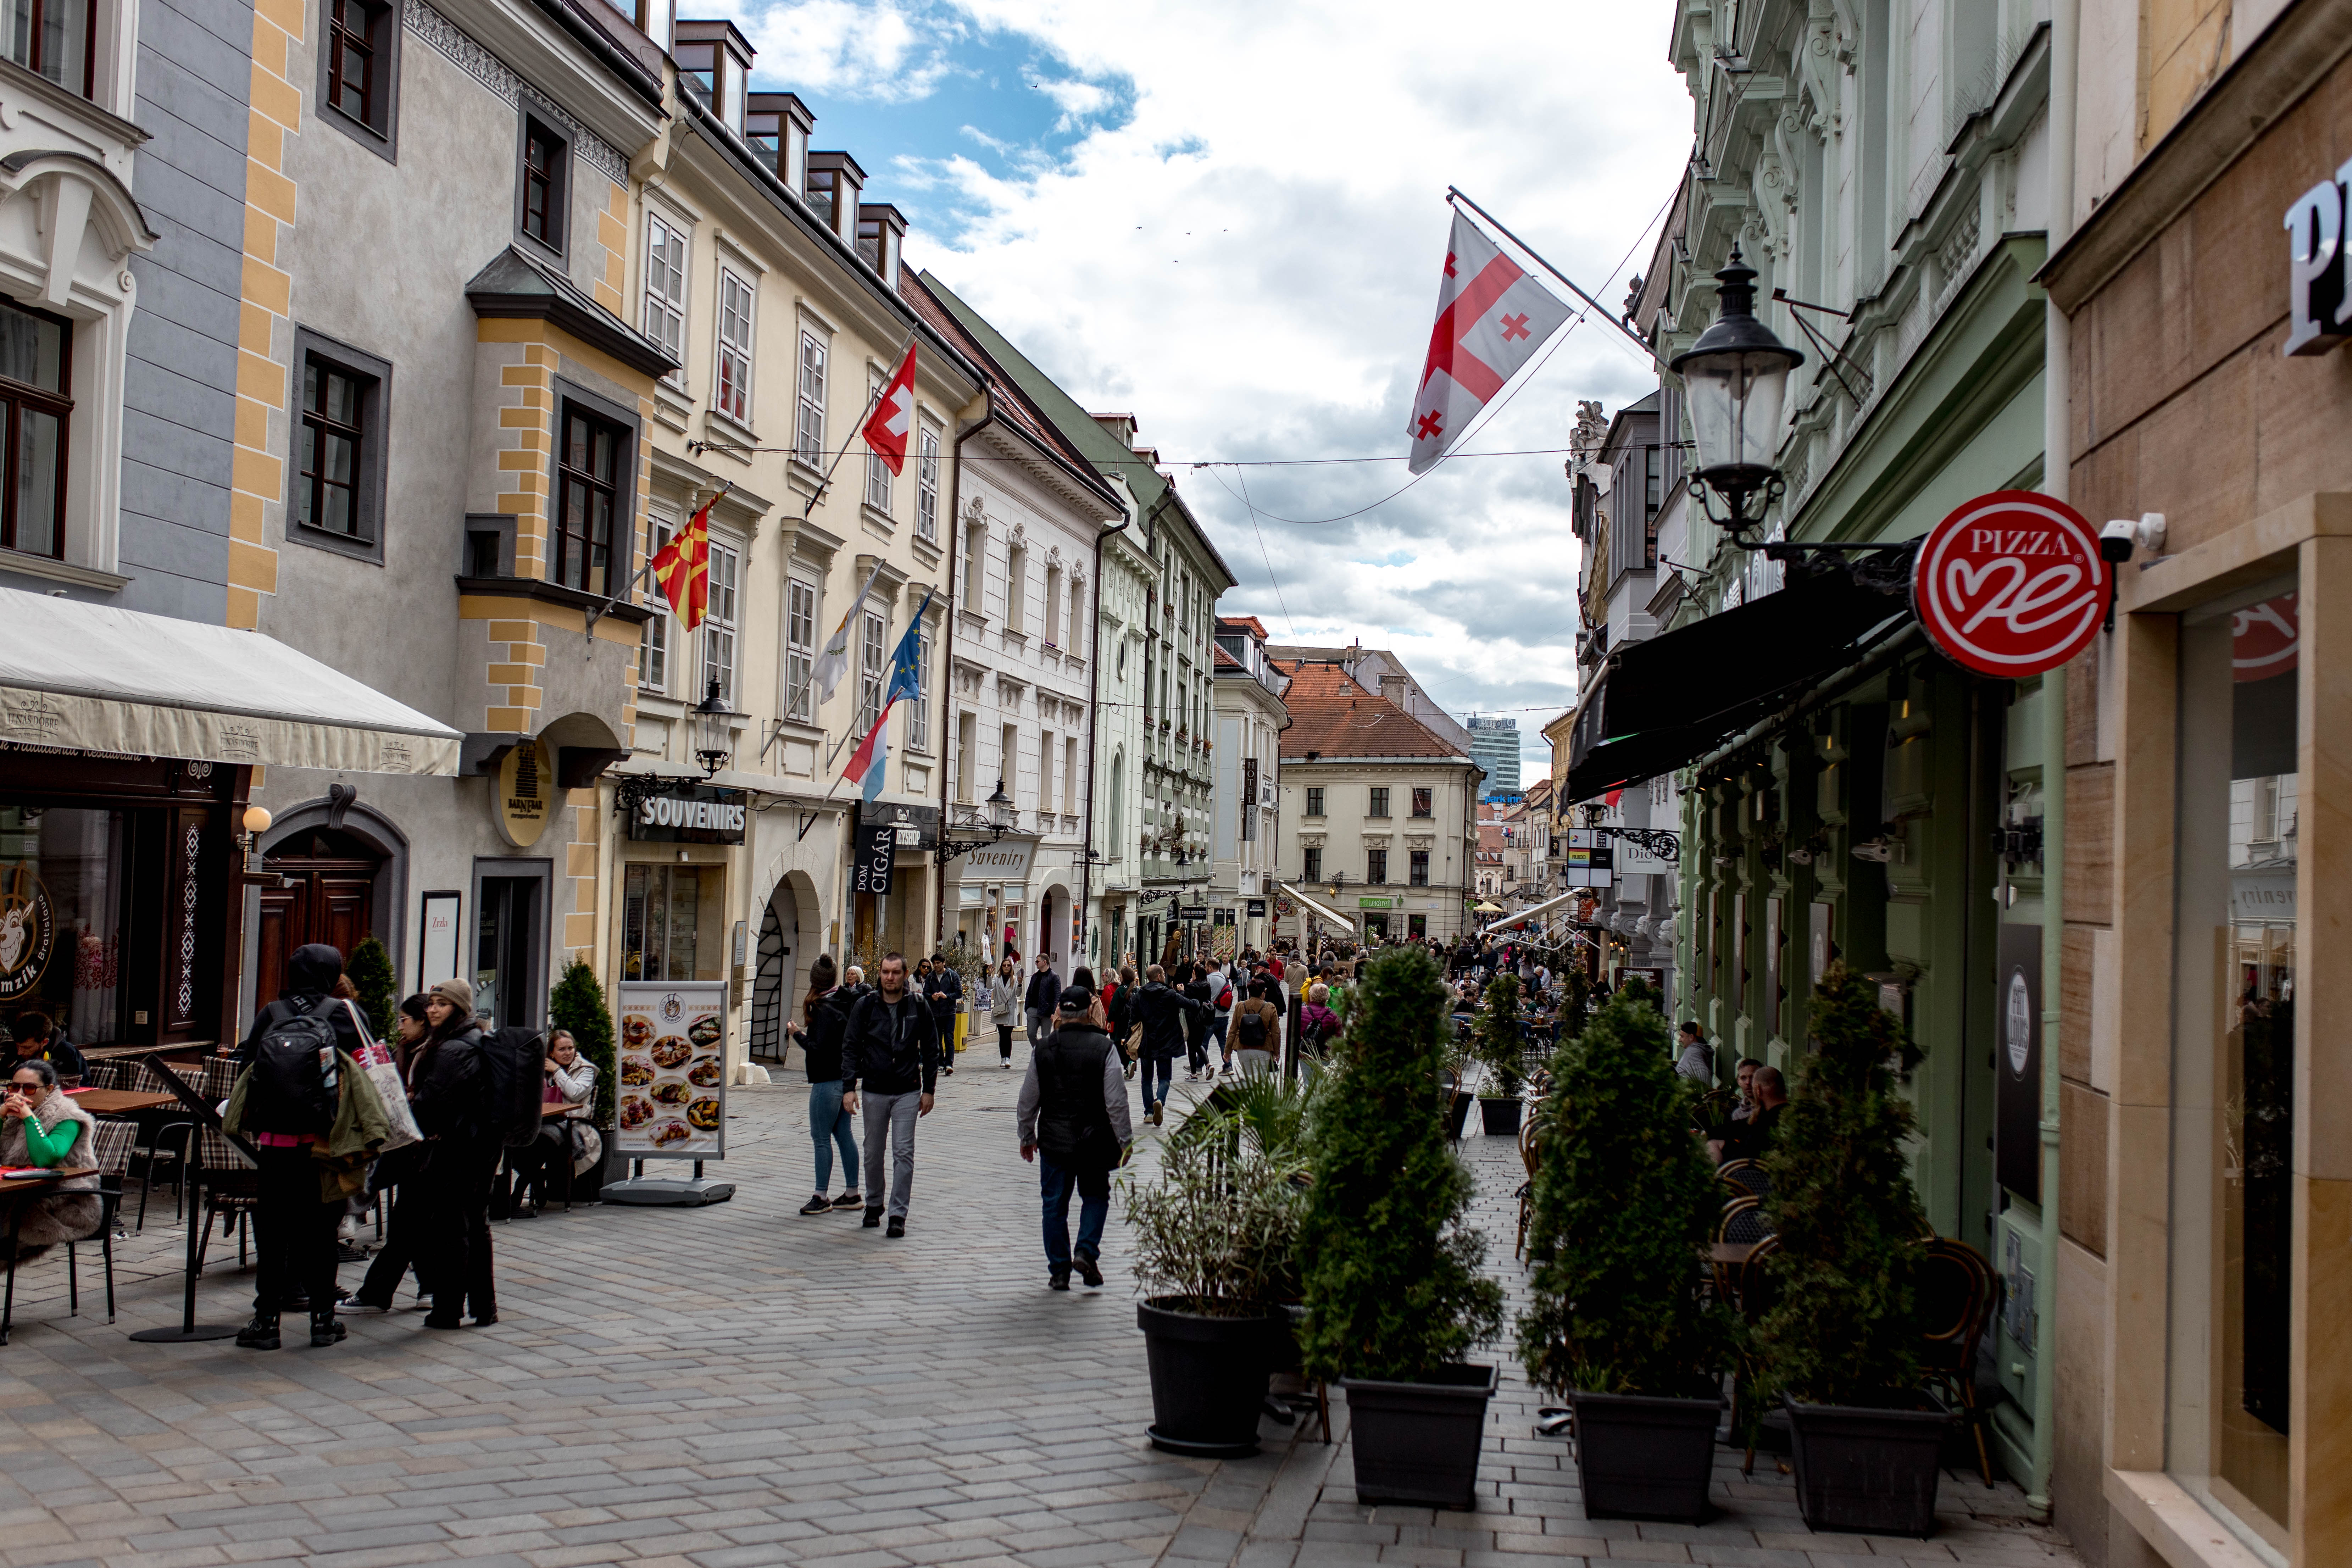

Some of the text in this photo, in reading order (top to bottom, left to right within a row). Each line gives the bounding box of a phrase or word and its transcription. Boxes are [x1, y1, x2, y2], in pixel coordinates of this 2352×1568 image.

[1970, 529, 2071, 556] PIZZA
[9, 712, 58, 730] U NÁS DOBRE
[239, 739, 258, 752] DOBRE
[1485, 794, 1522, 805] park inn
[640, 796, 745, 831] SOUVENIRS
[872, 829, 891, 893] CIGÁR
[968, 847, 1026, 870] Suveníry
[858, 864, 868, 891] DOM
[38, 894, 50, 961] Bratislava
